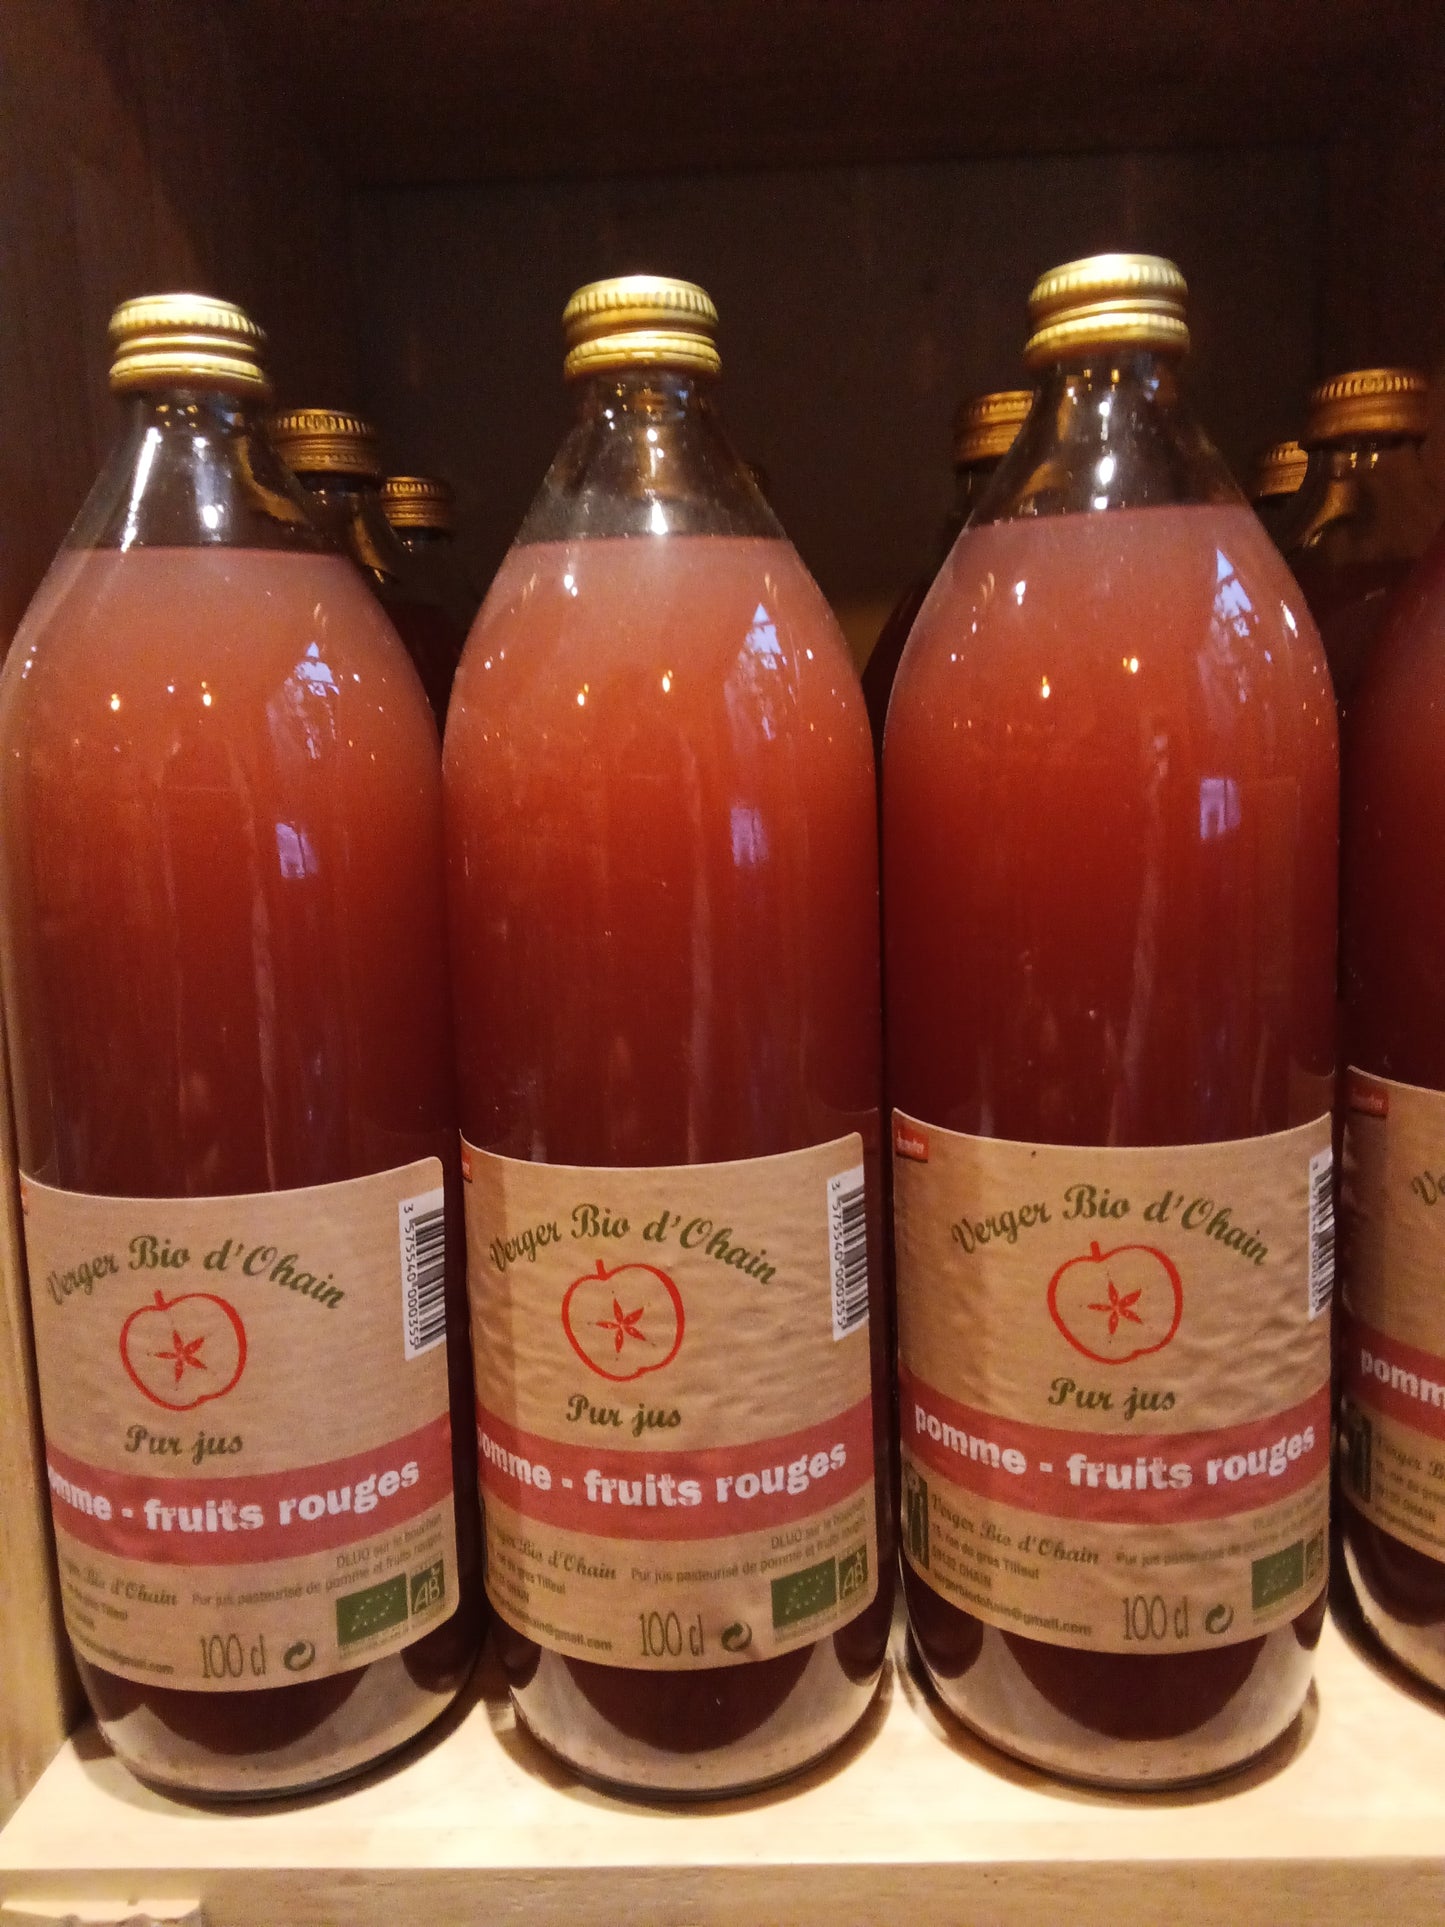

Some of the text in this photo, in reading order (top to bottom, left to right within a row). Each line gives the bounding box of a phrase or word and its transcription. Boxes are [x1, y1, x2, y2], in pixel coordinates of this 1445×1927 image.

[489, 1203, 777, 1286] Verger Bio d'Ohain
[951, 1183, 1269, 1268] Verger Bio d'Ohain
[47, 1235, 345, 1309] Verger Bio d'Ohain
[565, 1394, 681, 1438] Pur jus
[1048, 1377, 1177, 1421] Pur jus
[124, 1424, 244, 1465] Pur jus
[914, 1404, 1315, 1490] pomme - fruits rouges
[122, 1508, 134, 1518] -
[144, 1498, 264, 1532] fruits
[278, 1460, 419, 1526] rouges
[562, 1478, 573, 1489] -
[583, 1468, 702, 1507] fruits
[716, 1441, 847, 1504] rouges
[639, 1611, 683, 1656] 100
[1122, 1595, 1168, 1641] 100
[200, 1632, 243, 1678] 100
